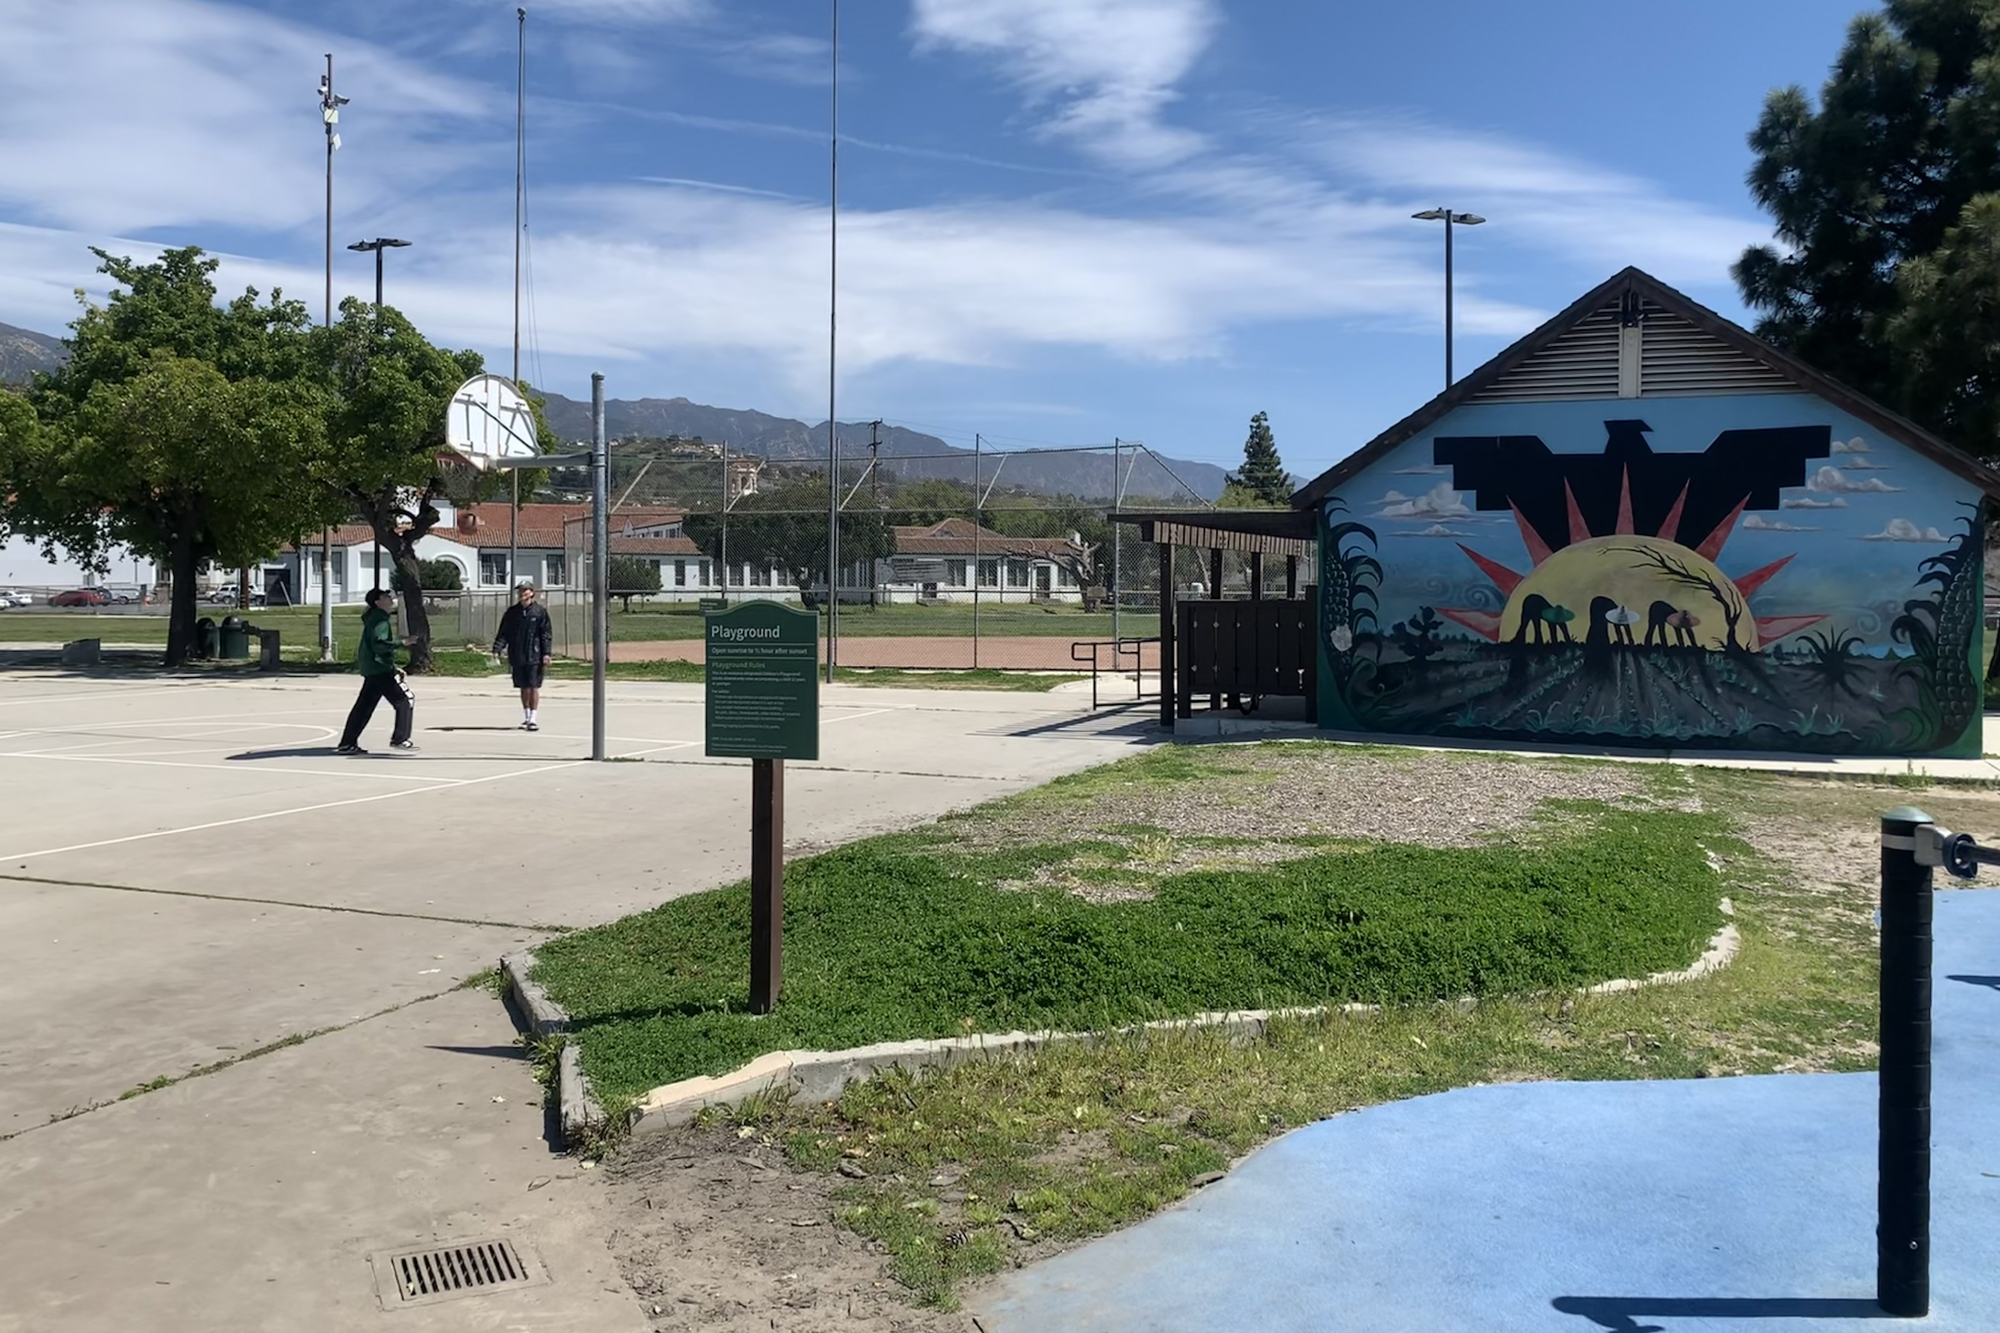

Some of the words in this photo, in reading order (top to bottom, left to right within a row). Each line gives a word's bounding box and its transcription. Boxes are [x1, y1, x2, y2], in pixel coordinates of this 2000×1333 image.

[711, 625, 780, 641] Playground
[711, 647, 727, 655] Open
[711, 661, 748, 670] Playground
[749, 661, 766, 669] Rules
